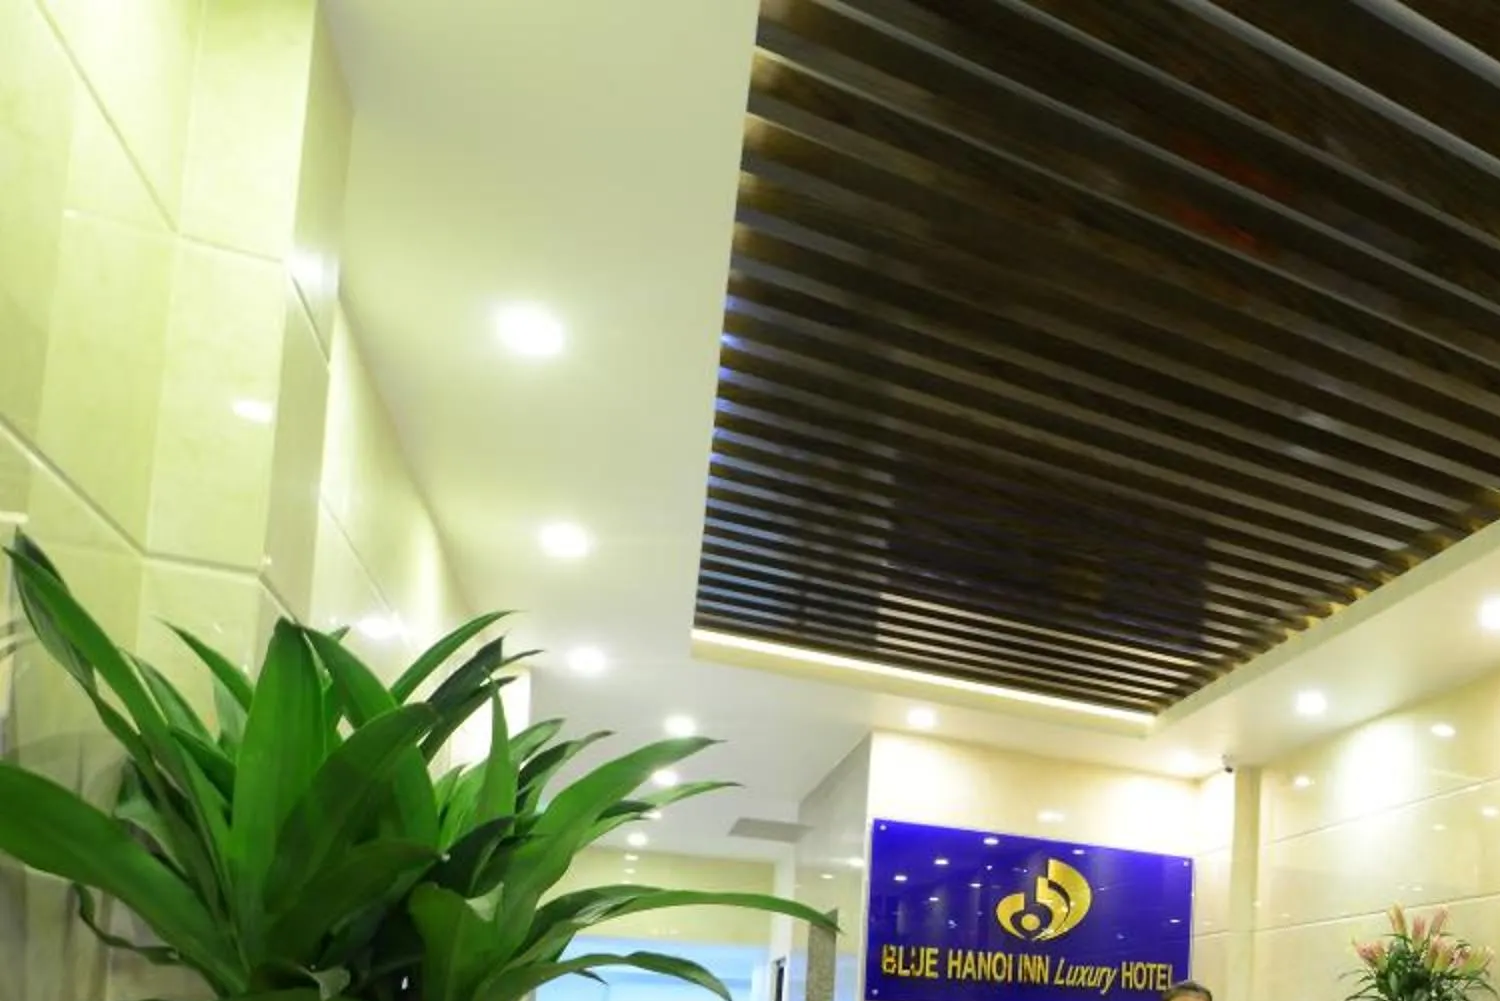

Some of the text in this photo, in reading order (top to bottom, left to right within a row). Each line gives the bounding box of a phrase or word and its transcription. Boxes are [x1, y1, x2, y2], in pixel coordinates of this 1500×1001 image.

[882, 943, 939, 979] BLUE
[947, 947, 1013, 983] HANOI
[1018, 952, 1049, 984] INN
[1054, 956, 1117, 996] Luxury
